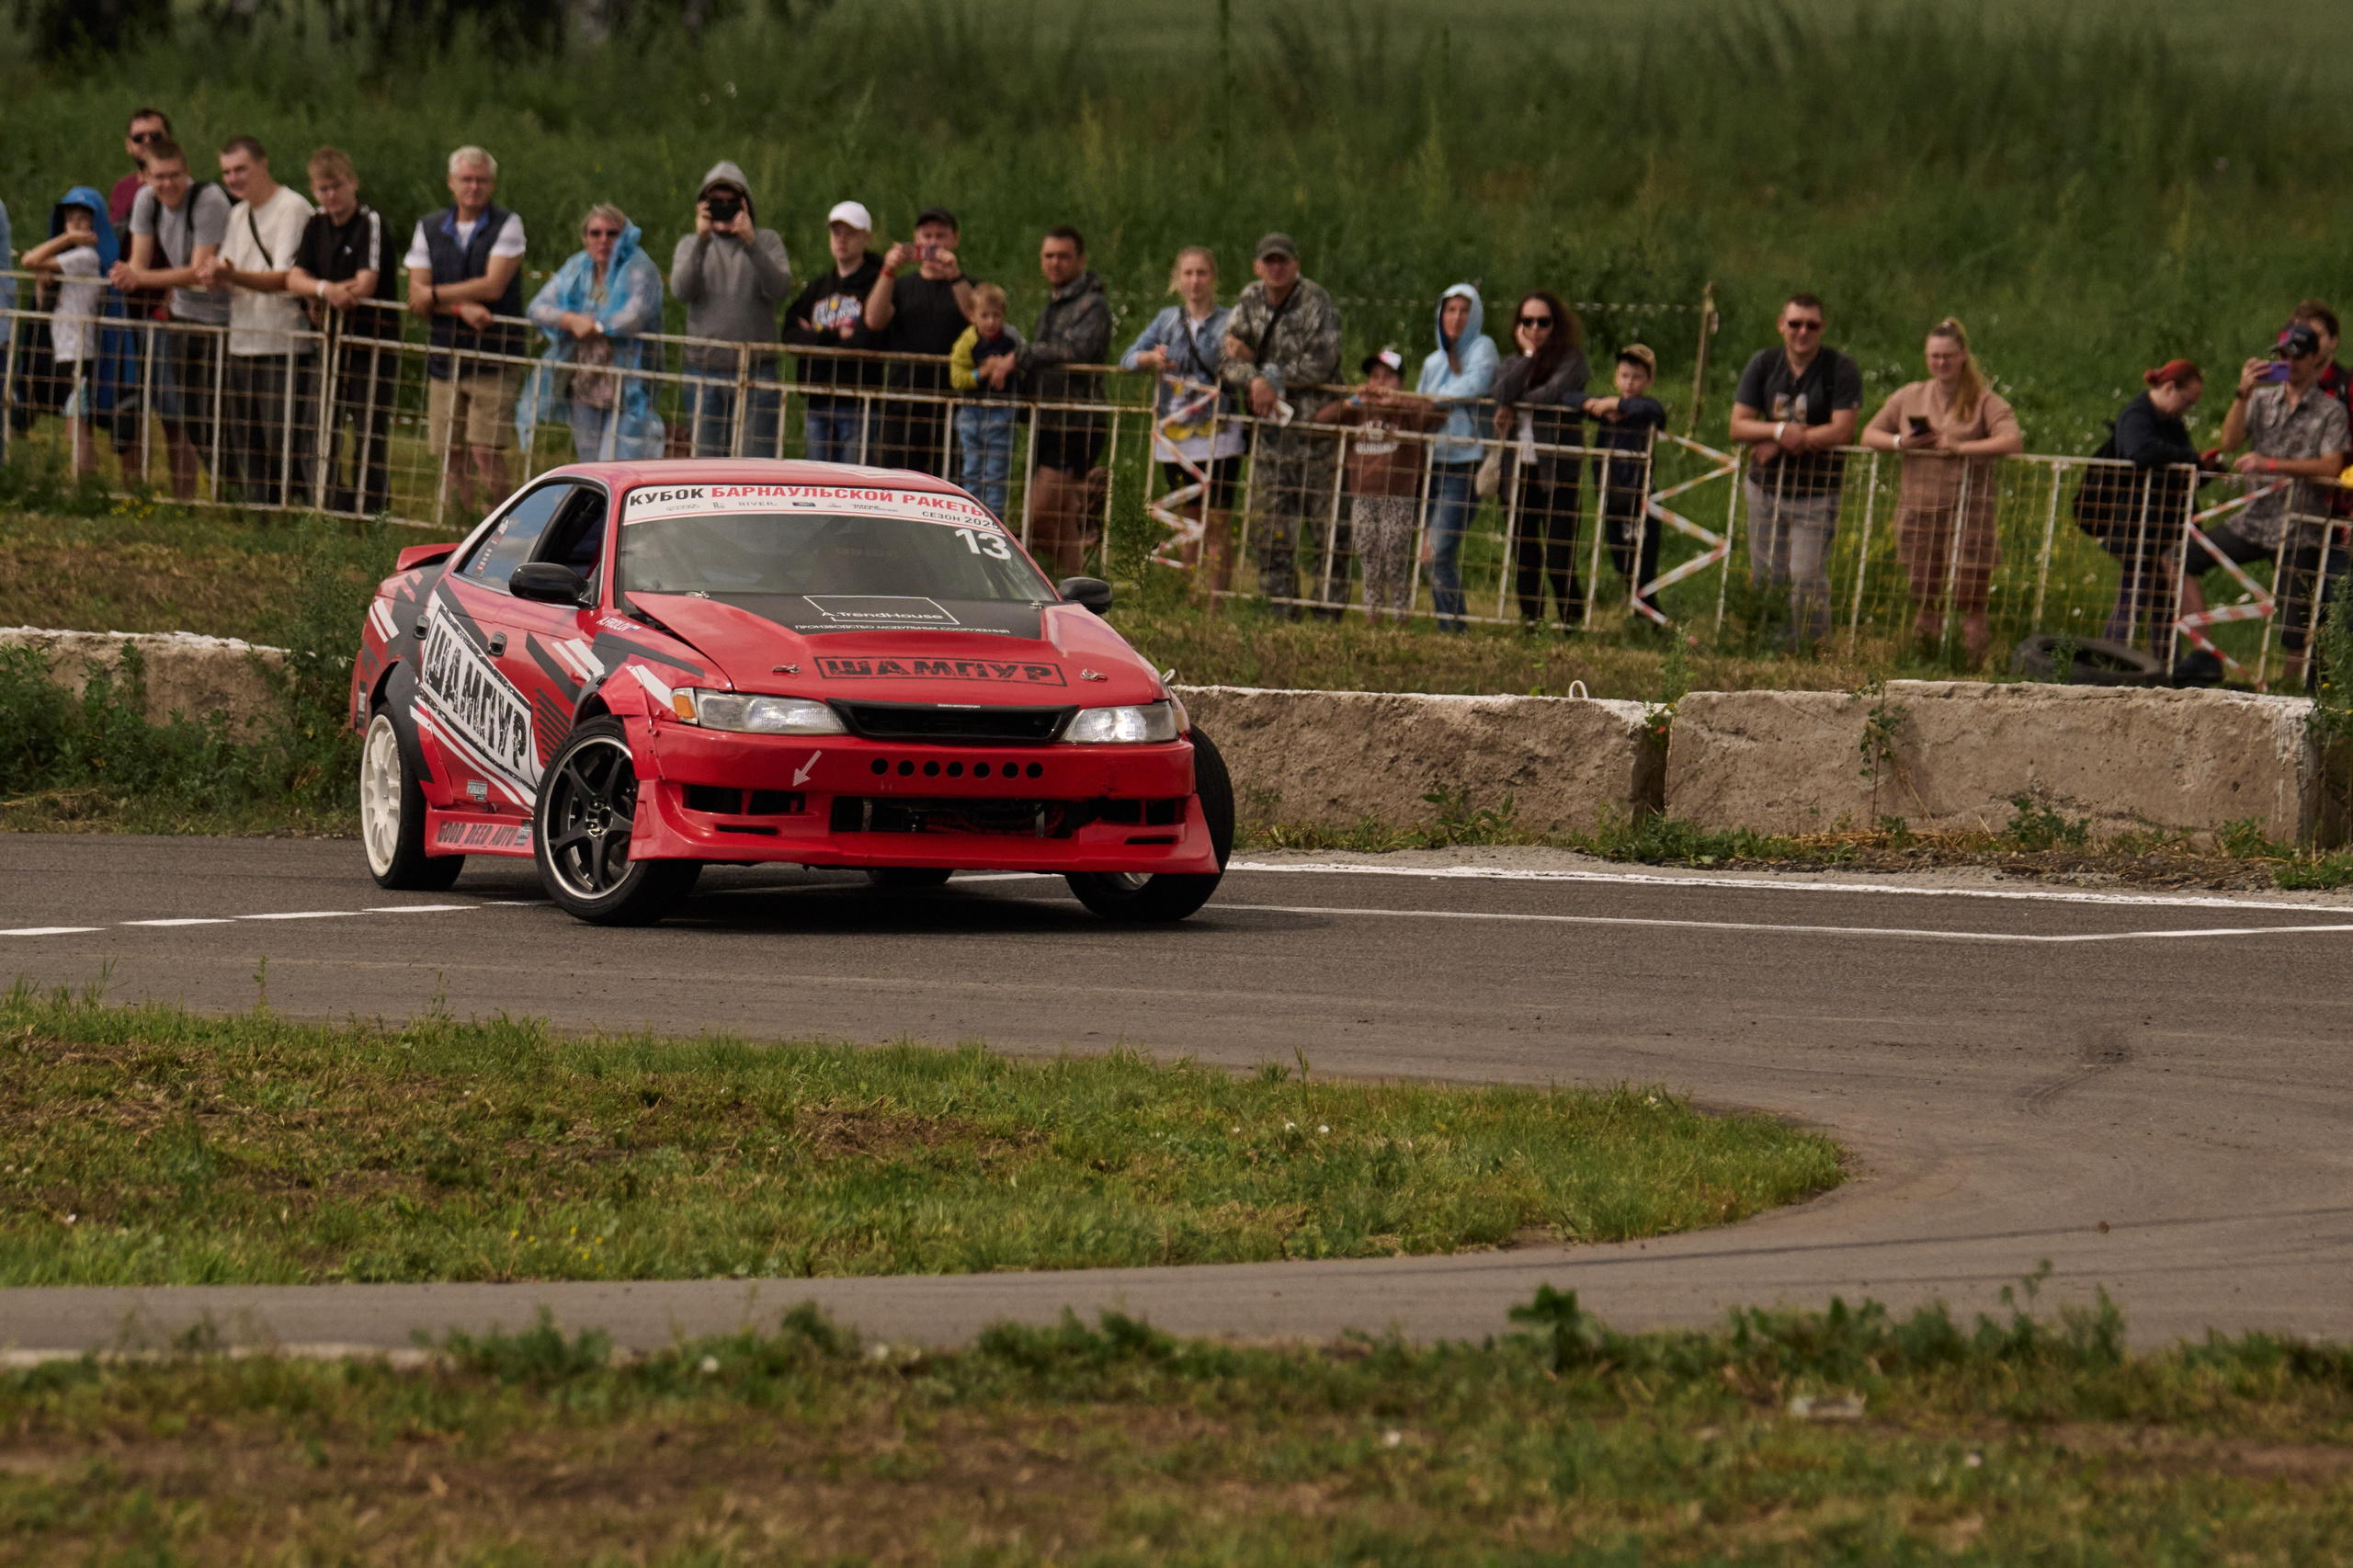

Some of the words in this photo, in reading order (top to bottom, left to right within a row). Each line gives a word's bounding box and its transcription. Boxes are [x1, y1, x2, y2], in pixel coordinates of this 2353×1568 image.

[630, 488, 704, 506] КУБОК
[711, 486, 893, 503] БАРНАУЛЬСКОЙ
[922, 511, 961, 521] СЕЗОН
[955, 528, 1012, 561] 13
[826, 660, 1052, 681] ШАМПУР
[424, 622, 528, 771] ШАМПУР
[438, 821, 467, 844] GOOD
[464, 824, 494, 846] DEED
[488, 825, 518, 847] AUTO
